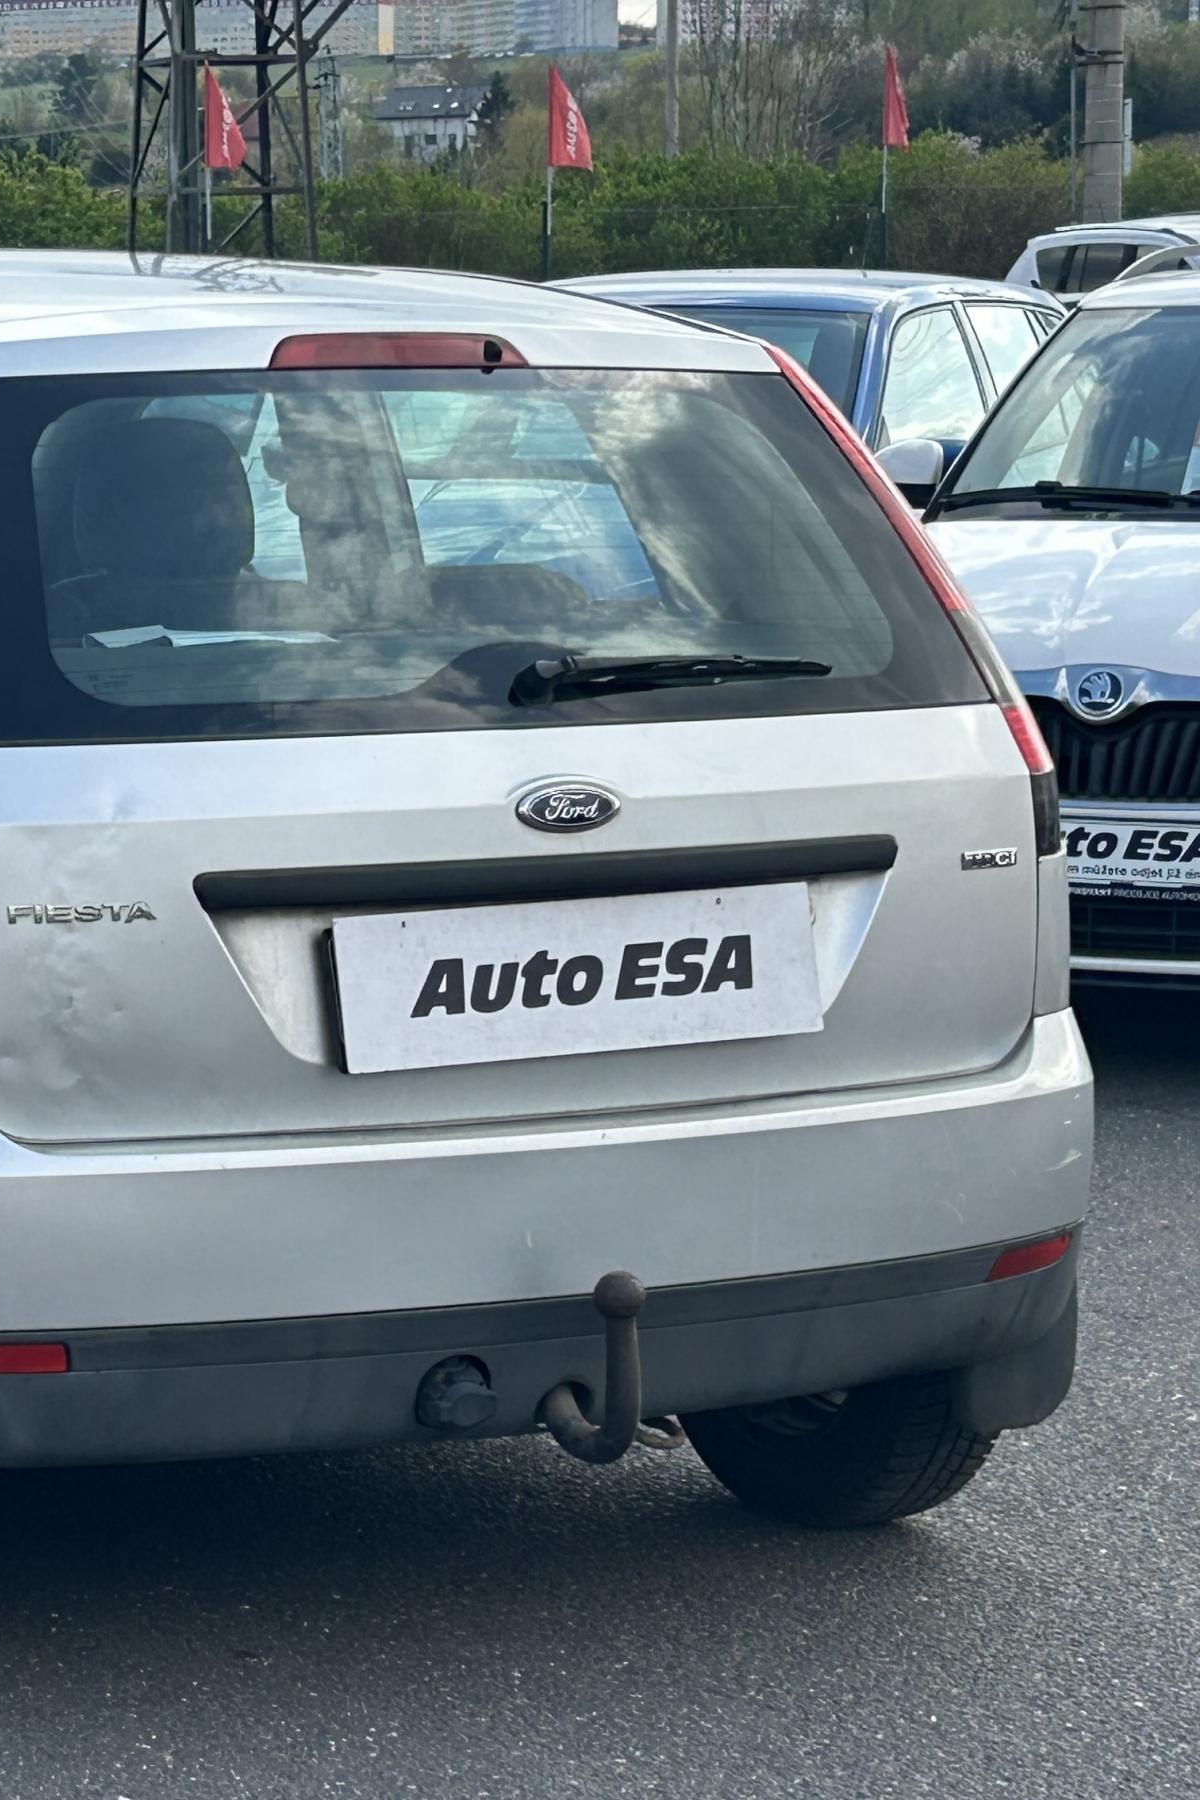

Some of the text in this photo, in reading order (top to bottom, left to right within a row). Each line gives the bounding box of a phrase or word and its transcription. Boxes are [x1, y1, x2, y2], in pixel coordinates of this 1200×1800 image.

[545, 793, 601, 820] Ford
[6, 900, 158, 926] FIESTA
[410, 934, 754, 1018] Auto ESA
